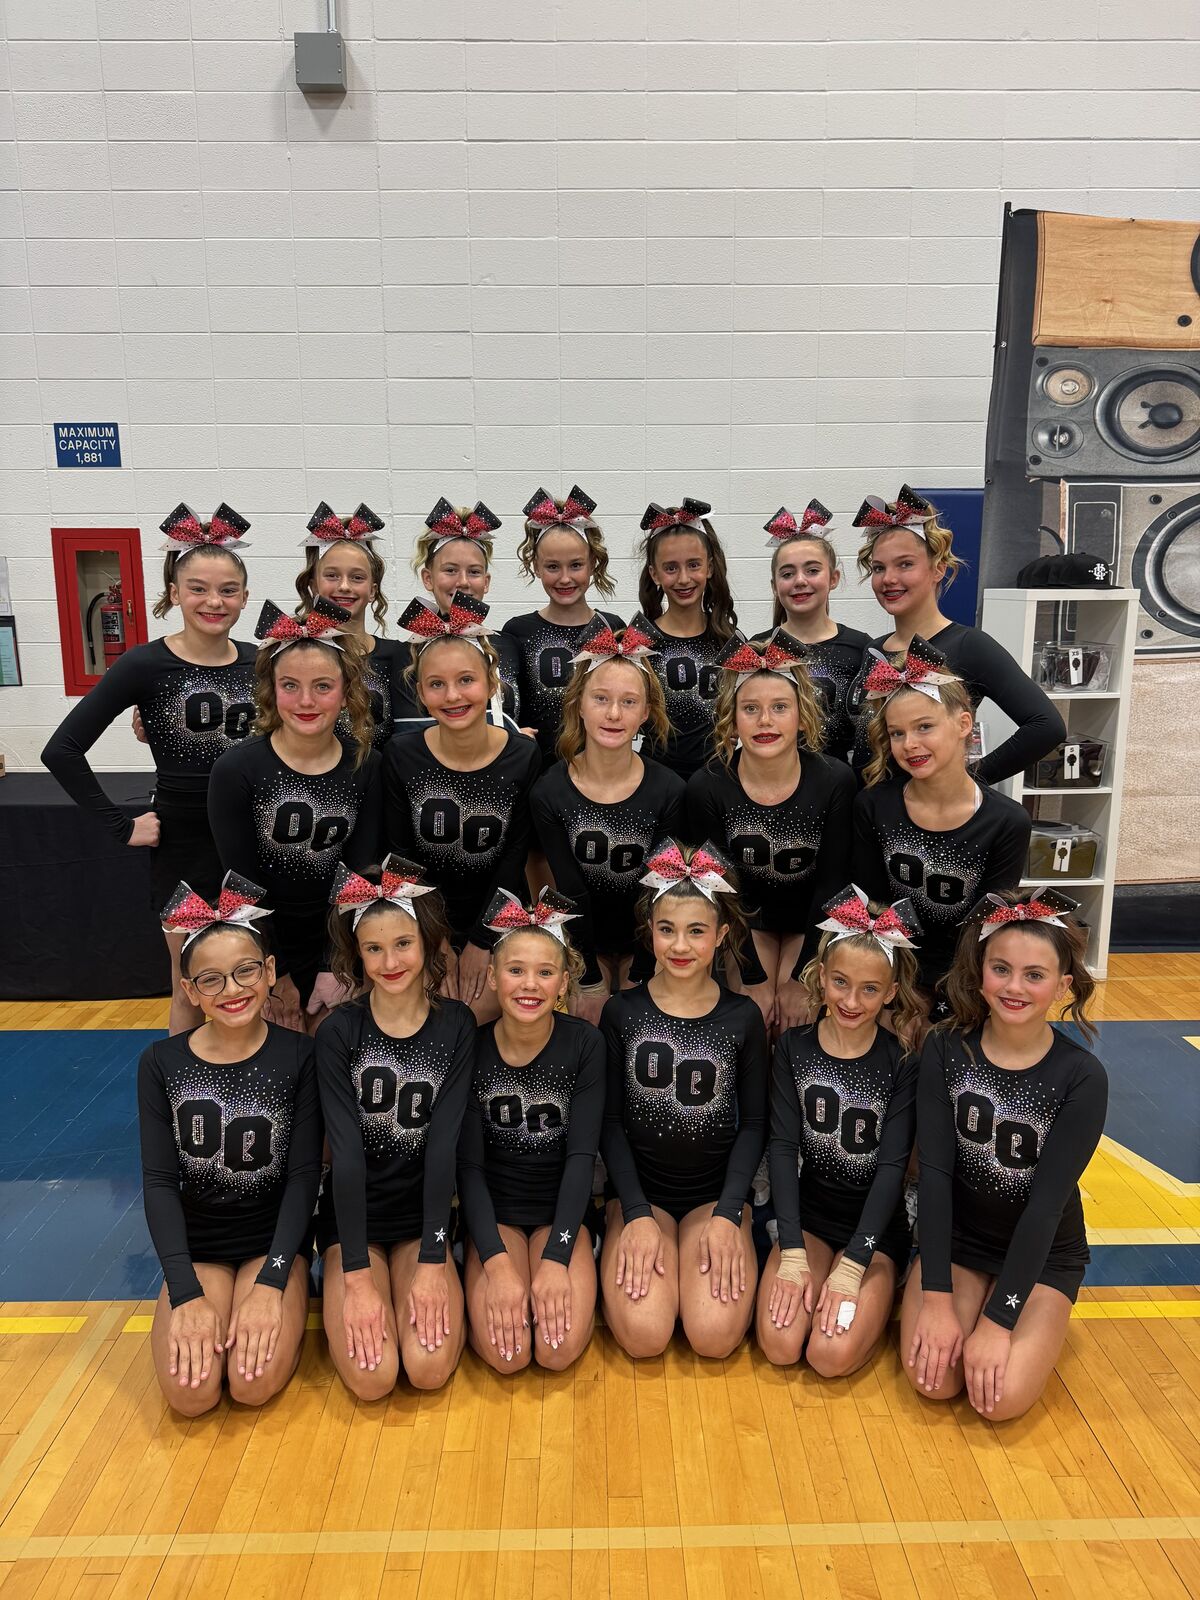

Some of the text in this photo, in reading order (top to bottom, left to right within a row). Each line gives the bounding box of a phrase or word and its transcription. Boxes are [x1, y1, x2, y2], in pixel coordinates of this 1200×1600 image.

[58, 427, 115, 438] MAXIMUM
[59, 439, 116, 451] CAPACITY
[75, 452, 102, 465] 1,881
